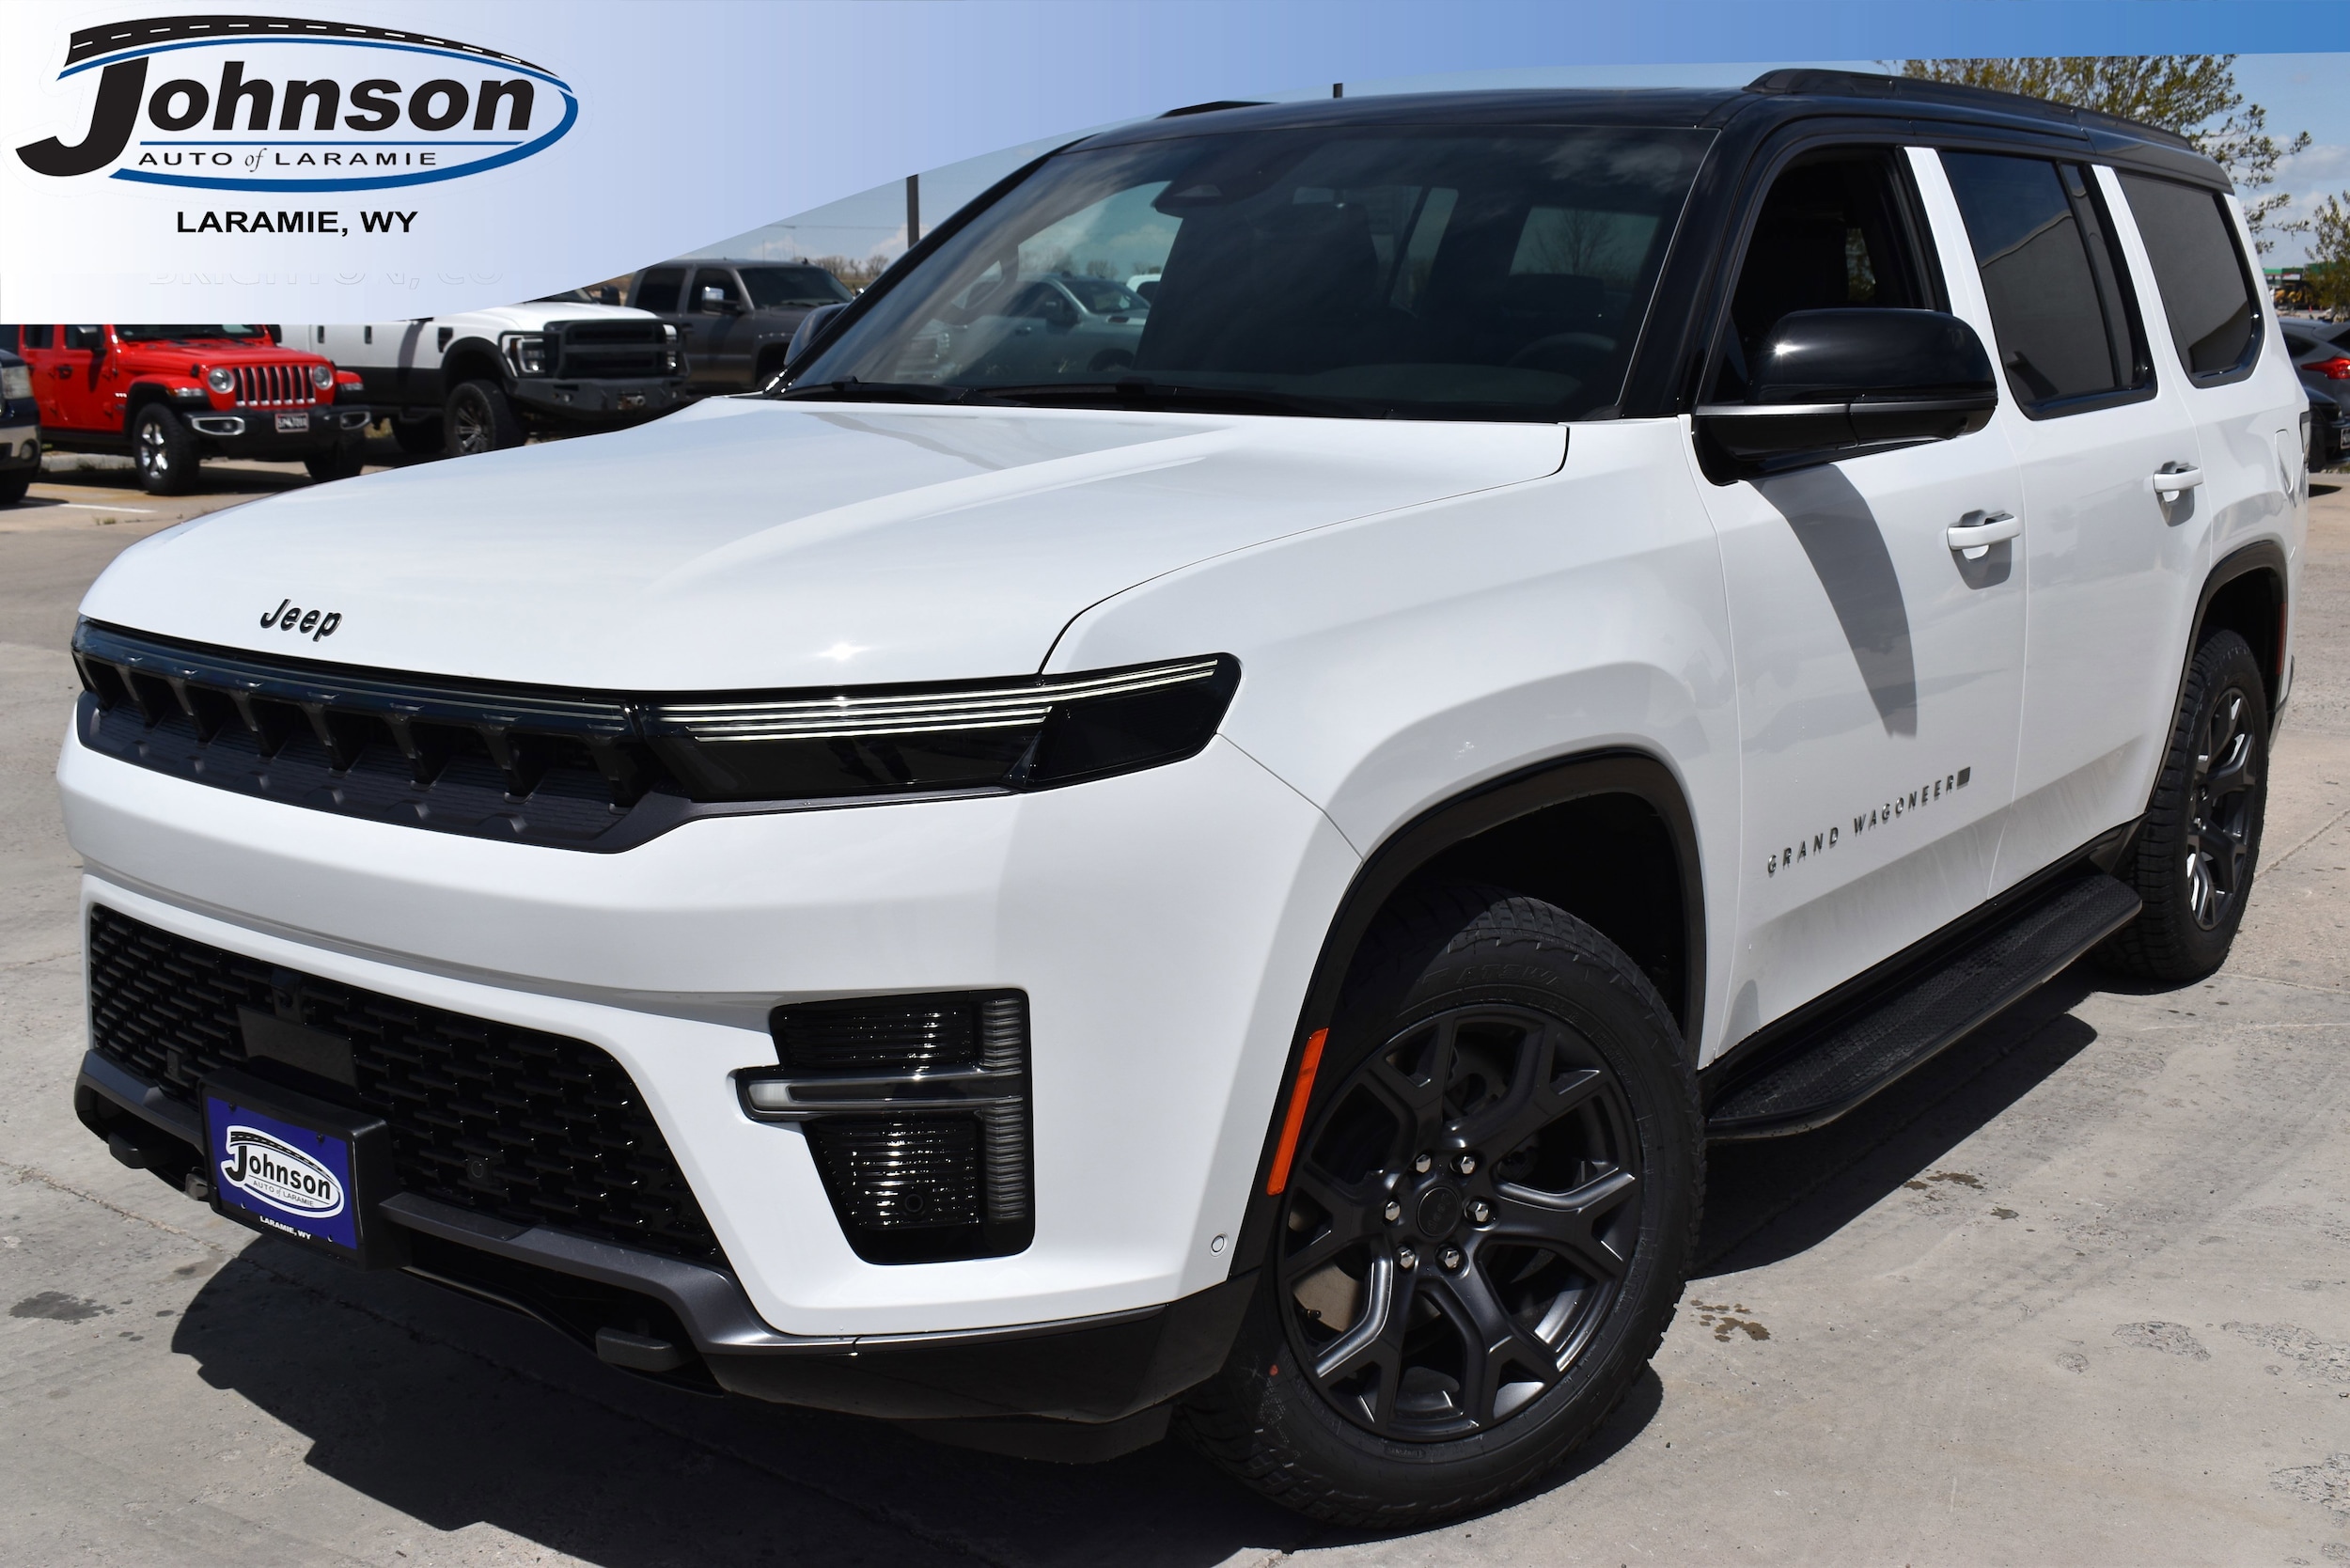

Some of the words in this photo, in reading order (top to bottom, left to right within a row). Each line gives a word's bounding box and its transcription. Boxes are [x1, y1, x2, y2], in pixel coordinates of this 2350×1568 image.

[260, 598, 342, 642] Jeep
[1767, 826, 1839, 875] GRAND
[1854, 775, 1954, 836] WAGONEER
[225, 1145, 331, 1200] Johnson
[253, 1180, 274, 1193] AUTO
[275, 1187, 282, 1197] of
[282, 1192, 314, 1207] LARAMIE
[259, 1215, 296, 1235] LARAMIE,
[297, 1230, 311, 1240] WY
